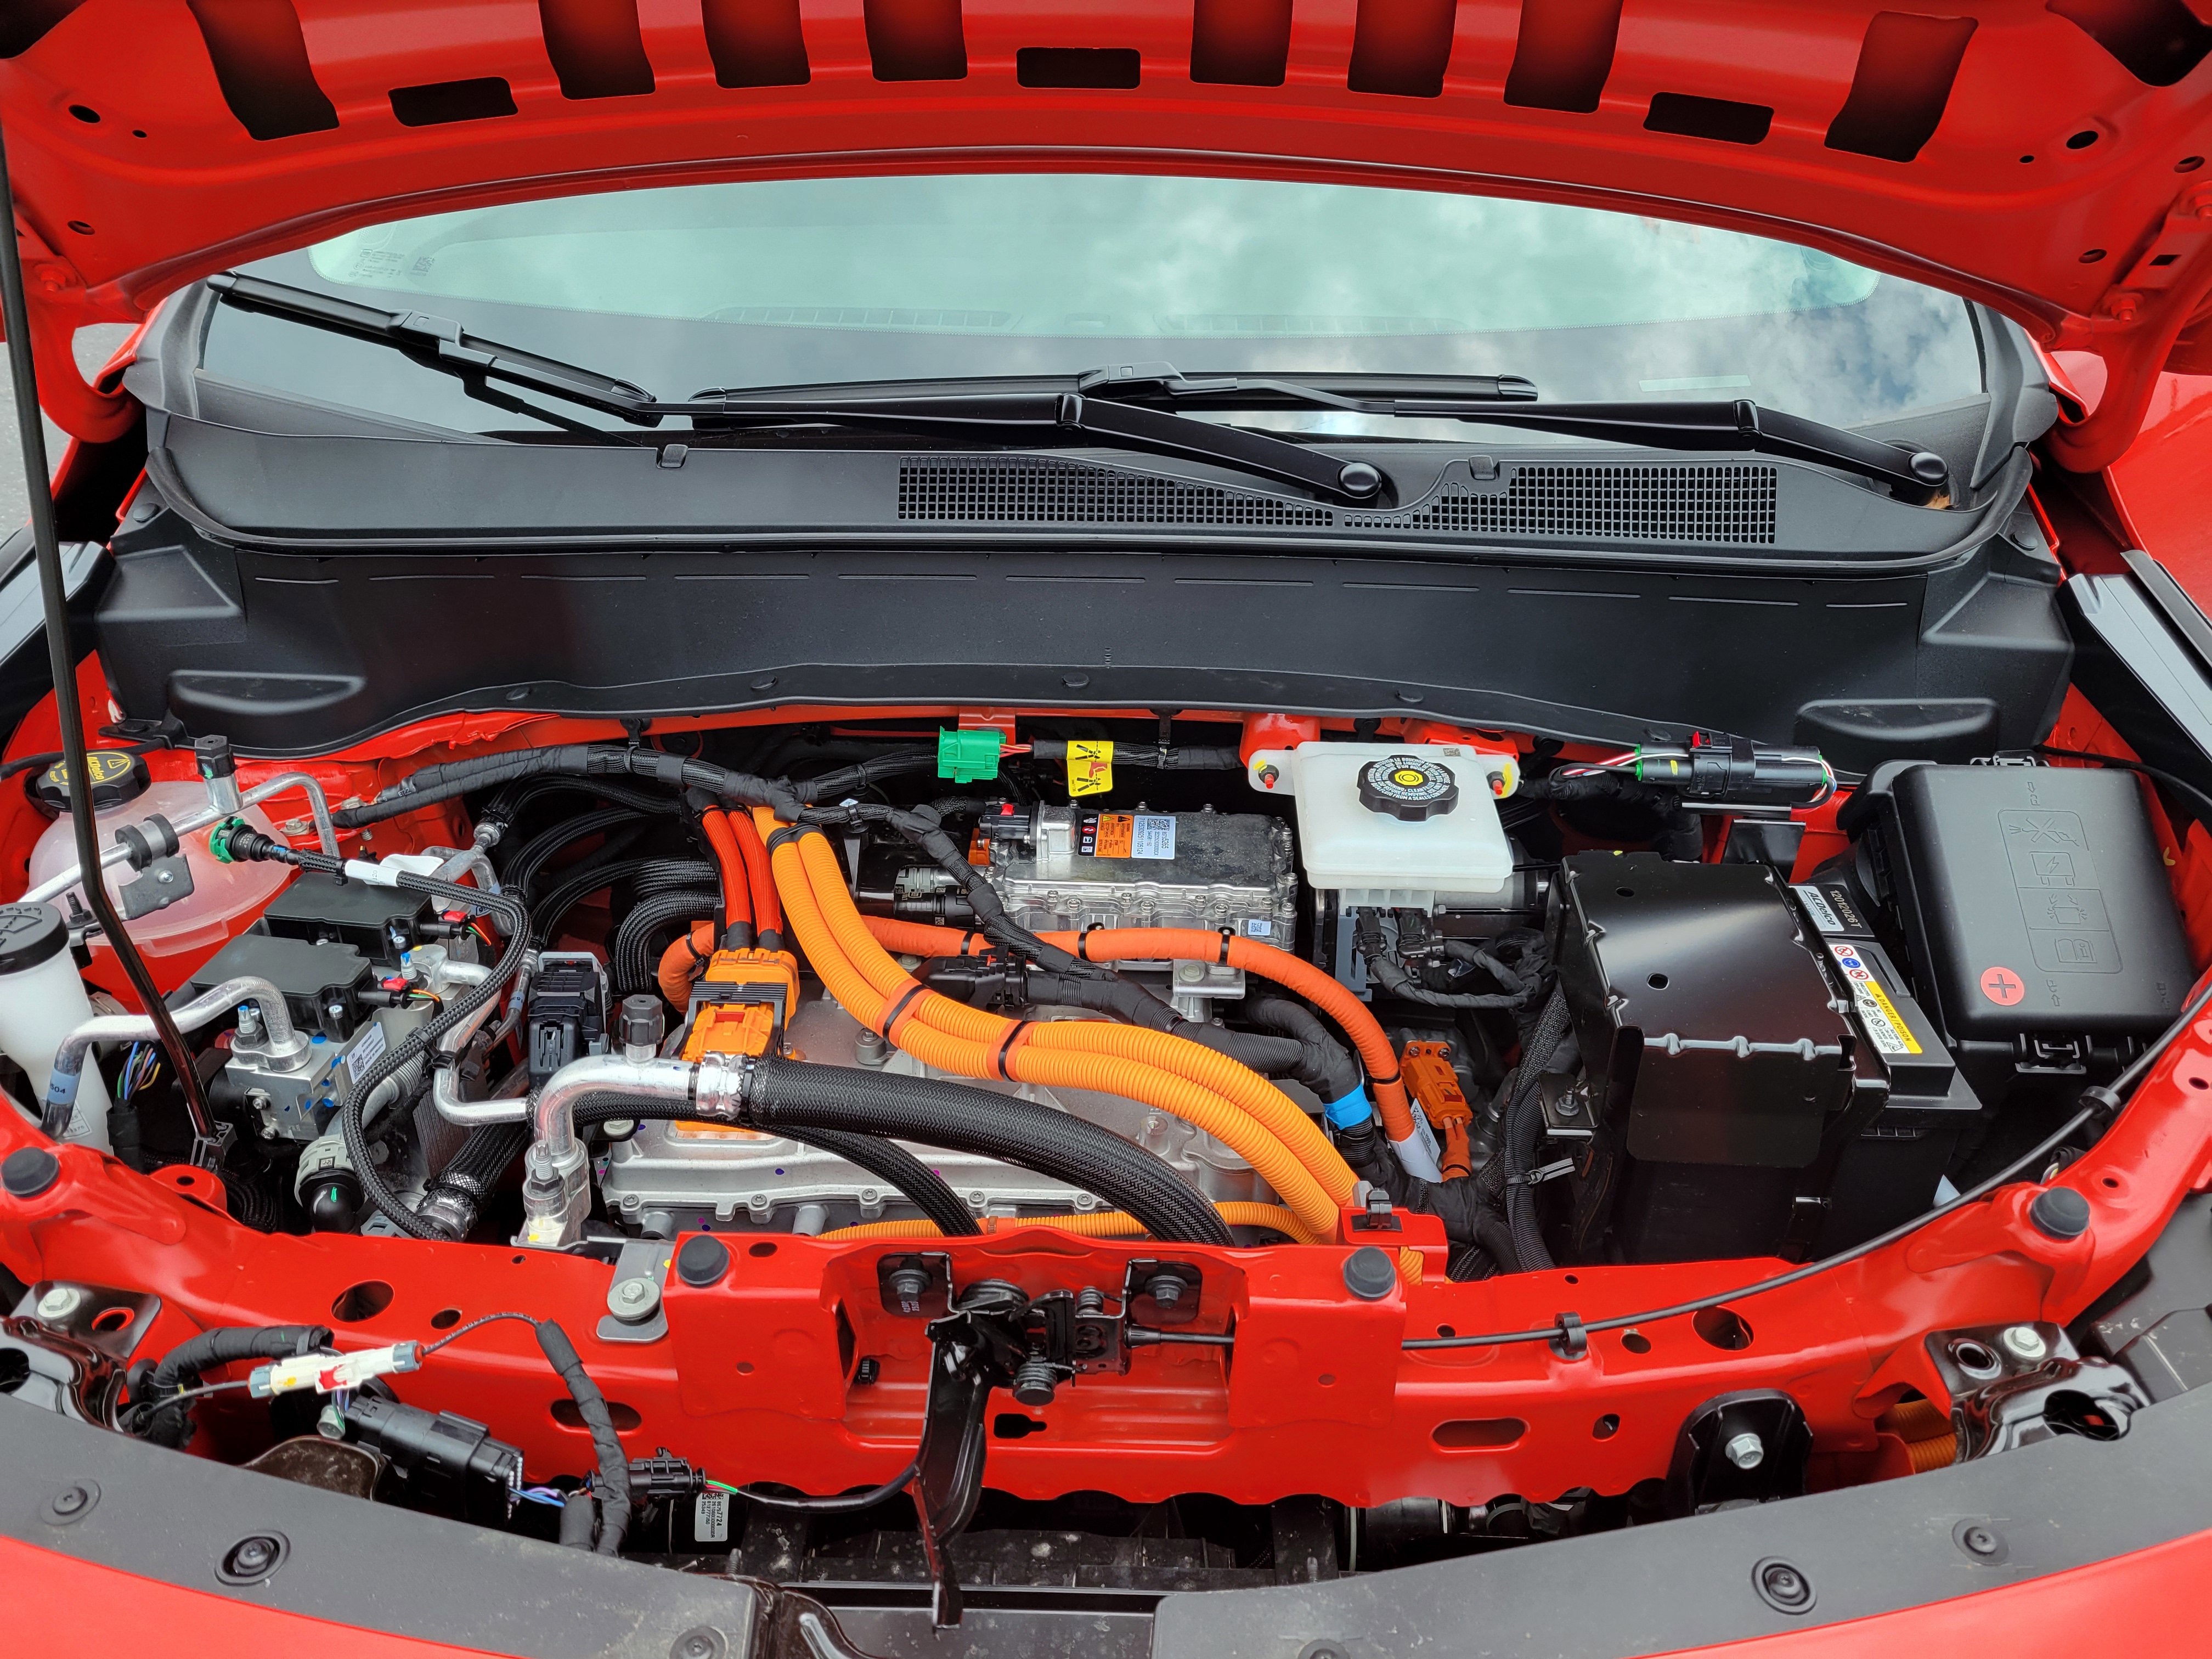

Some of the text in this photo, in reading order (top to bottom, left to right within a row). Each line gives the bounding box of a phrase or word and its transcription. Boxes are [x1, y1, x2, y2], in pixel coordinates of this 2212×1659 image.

[1807, 891, 1836, 926] ACDelco
[1830, 890, 1863, 929] 12012026T
[1878, 998, 1897, 1019] DANGER
[1894, 1022, 1912, 1042] POISON
